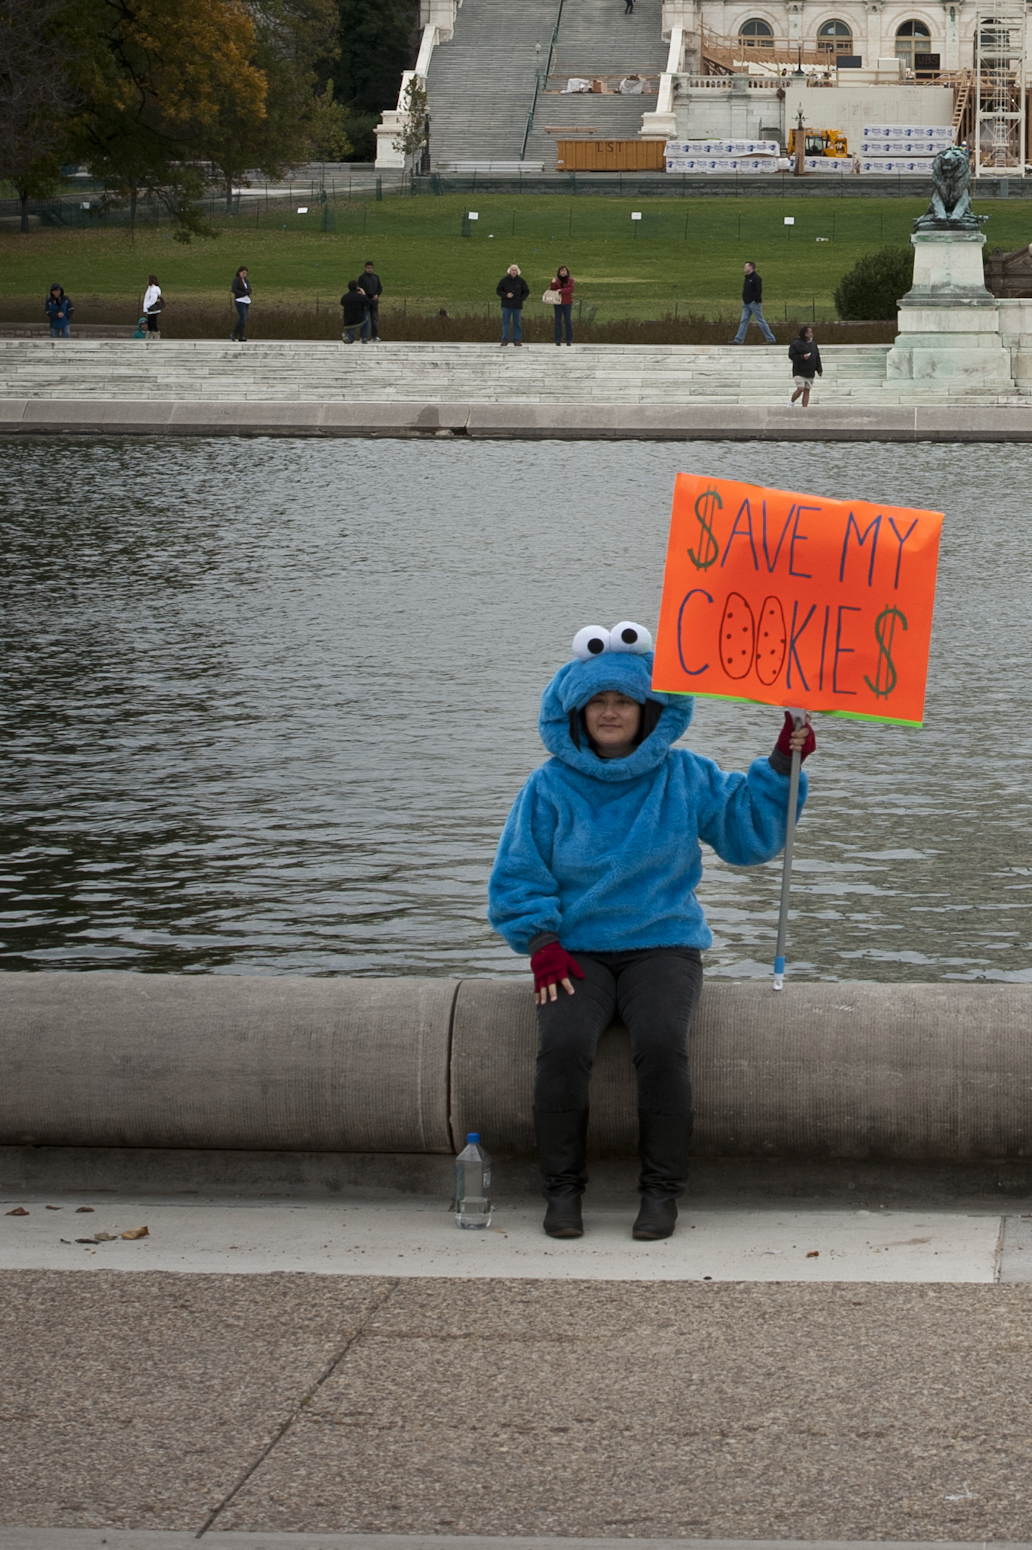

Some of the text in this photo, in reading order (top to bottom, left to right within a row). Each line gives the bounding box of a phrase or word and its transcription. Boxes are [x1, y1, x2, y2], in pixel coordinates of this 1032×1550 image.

[687, 485, 918, 590] $AVE MY
[677, 588, 908, 700] COOKIE$
